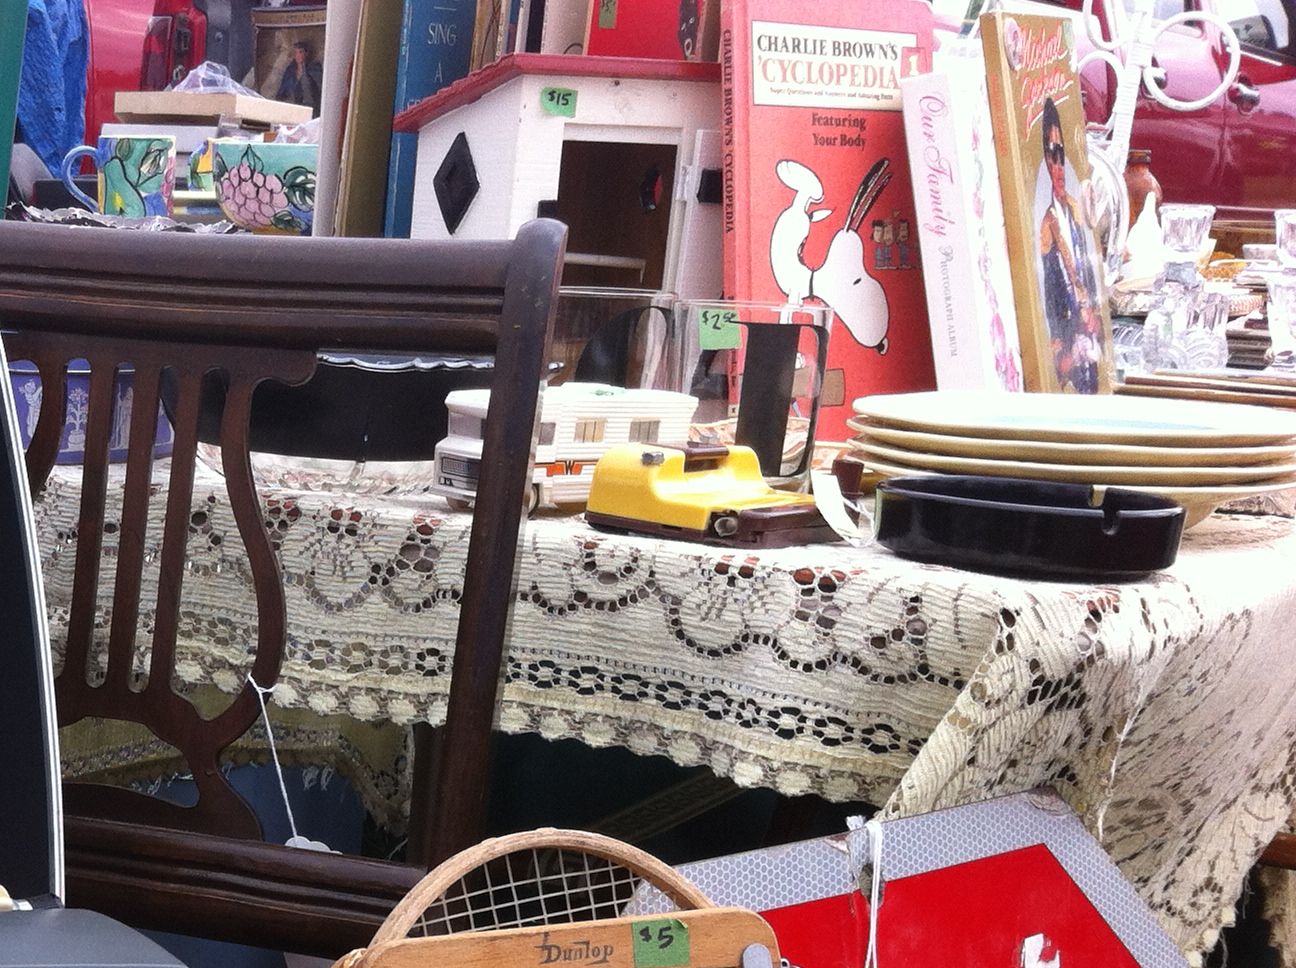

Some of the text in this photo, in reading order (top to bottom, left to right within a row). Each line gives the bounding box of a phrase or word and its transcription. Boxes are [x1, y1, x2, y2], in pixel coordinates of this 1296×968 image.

[427, 22, 457, 46] SING
[722, 29, 733, 85] CHARLIE
[757, 34, 899, 62] CHARLIE BROWN'S
[434, 62, 443, 83] A
[758, 55, 902, 90] 'CYCLOPEDIA
[548, 90, 572, 106] $15
[723, 88, 734, 146] BROWN'S
[811, 112, 867, 131] Featuring
[811, 132, 867, 151] Your Body
[919, 90, 956, 237] Our Family
[535, 932, 614, 967] Dunlop
[639, 925, 674, 949] $5
